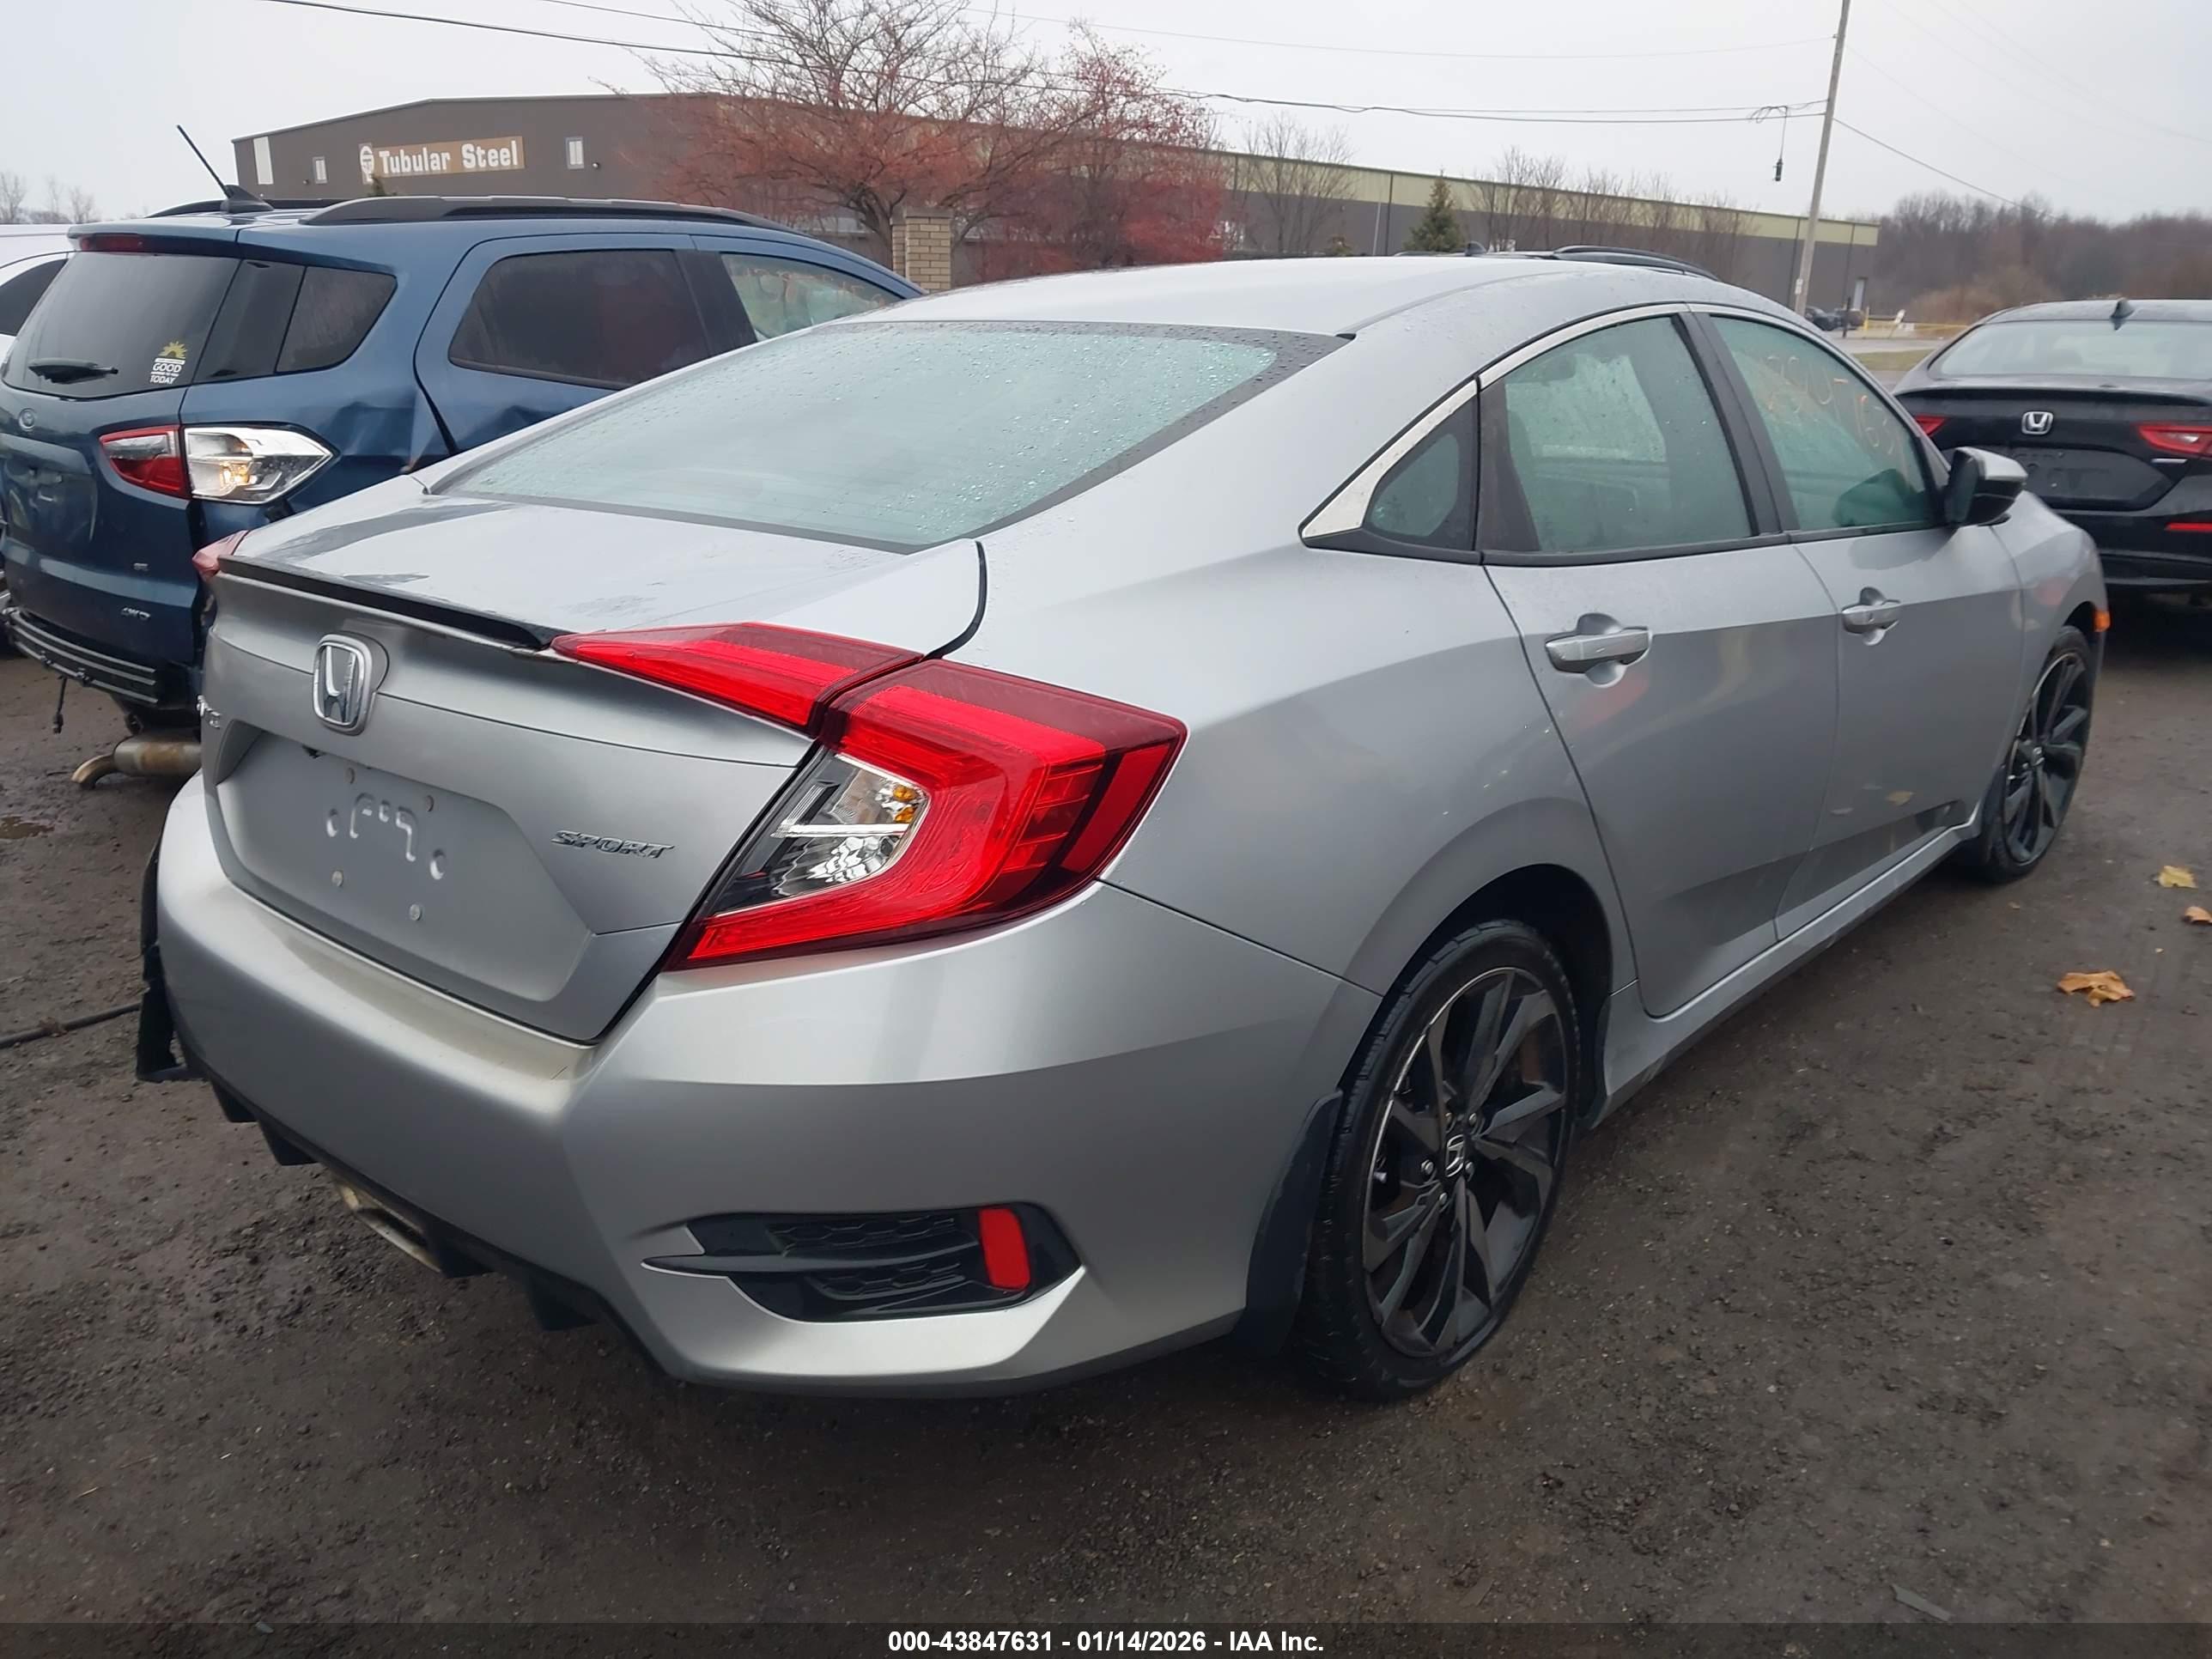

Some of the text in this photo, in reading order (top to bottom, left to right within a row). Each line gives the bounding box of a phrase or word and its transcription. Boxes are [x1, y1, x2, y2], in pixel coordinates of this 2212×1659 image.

[379, 147, 451, 173] Tubular
[461, 140, 519, 169] Steel
[153, 362, 182, 373] GOOD
[149, 374, 176, 385] TODAY
[551, 830, 675, 859] SPORT
